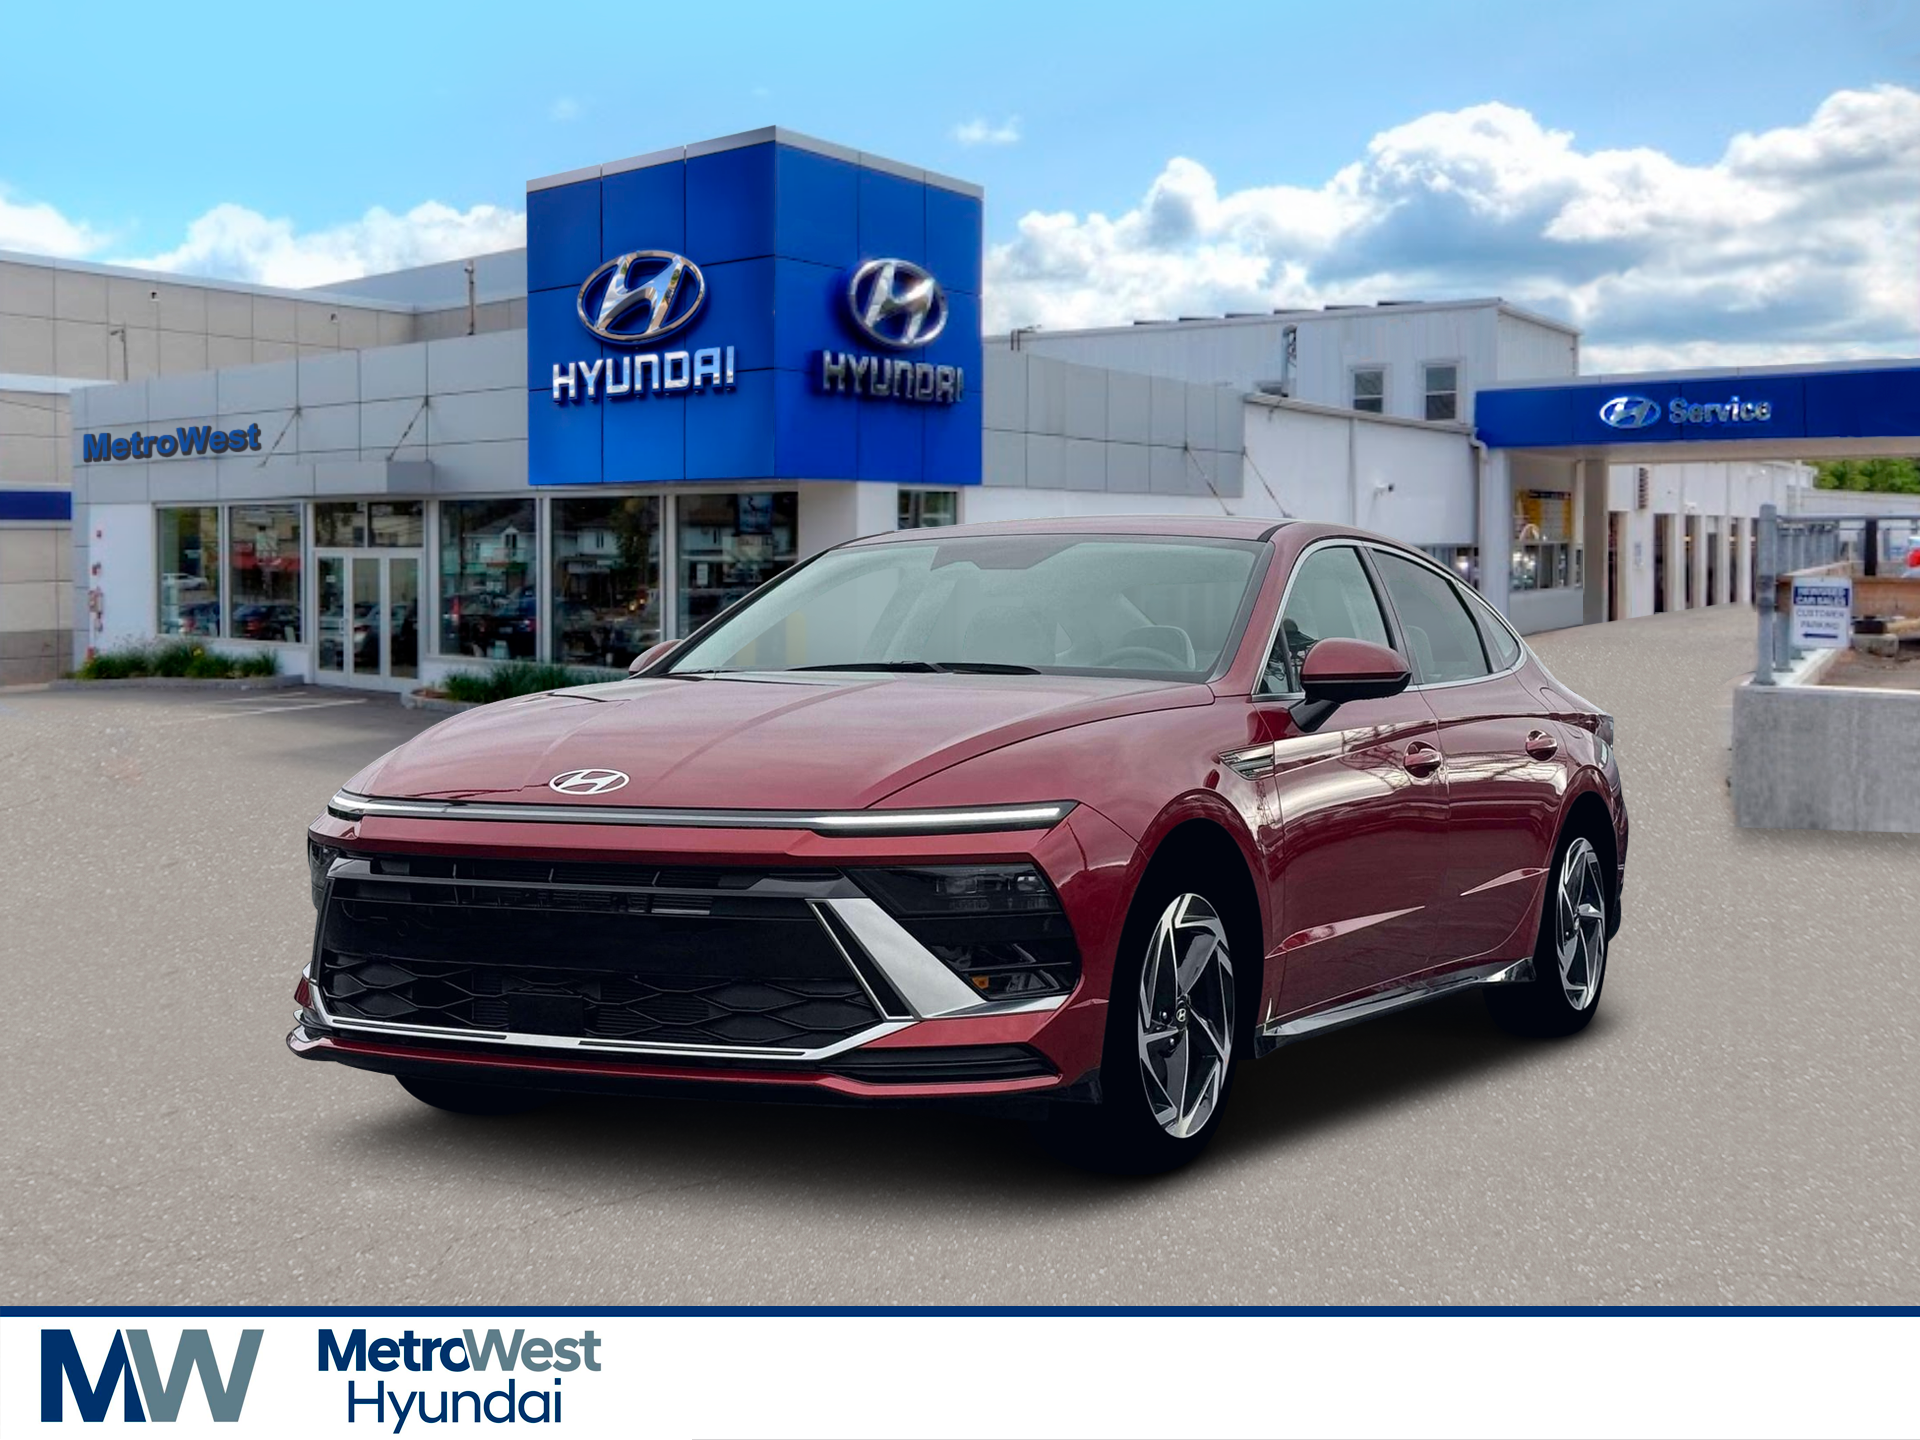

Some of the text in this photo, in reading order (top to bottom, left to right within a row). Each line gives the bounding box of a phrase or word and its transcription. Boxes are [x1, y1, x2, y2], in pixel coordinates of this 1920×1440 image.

[552, 345, 736, 404] HYUNDAI
[820, 349, 966, 404] HYUNDAI
[1668, 396, 1772, 425] Service
[82, 422, 263, 464] MetroWest
[1796, 609, 1845, 619] CUSTOMER
[1800, 620, 1840, 630] PARKING
